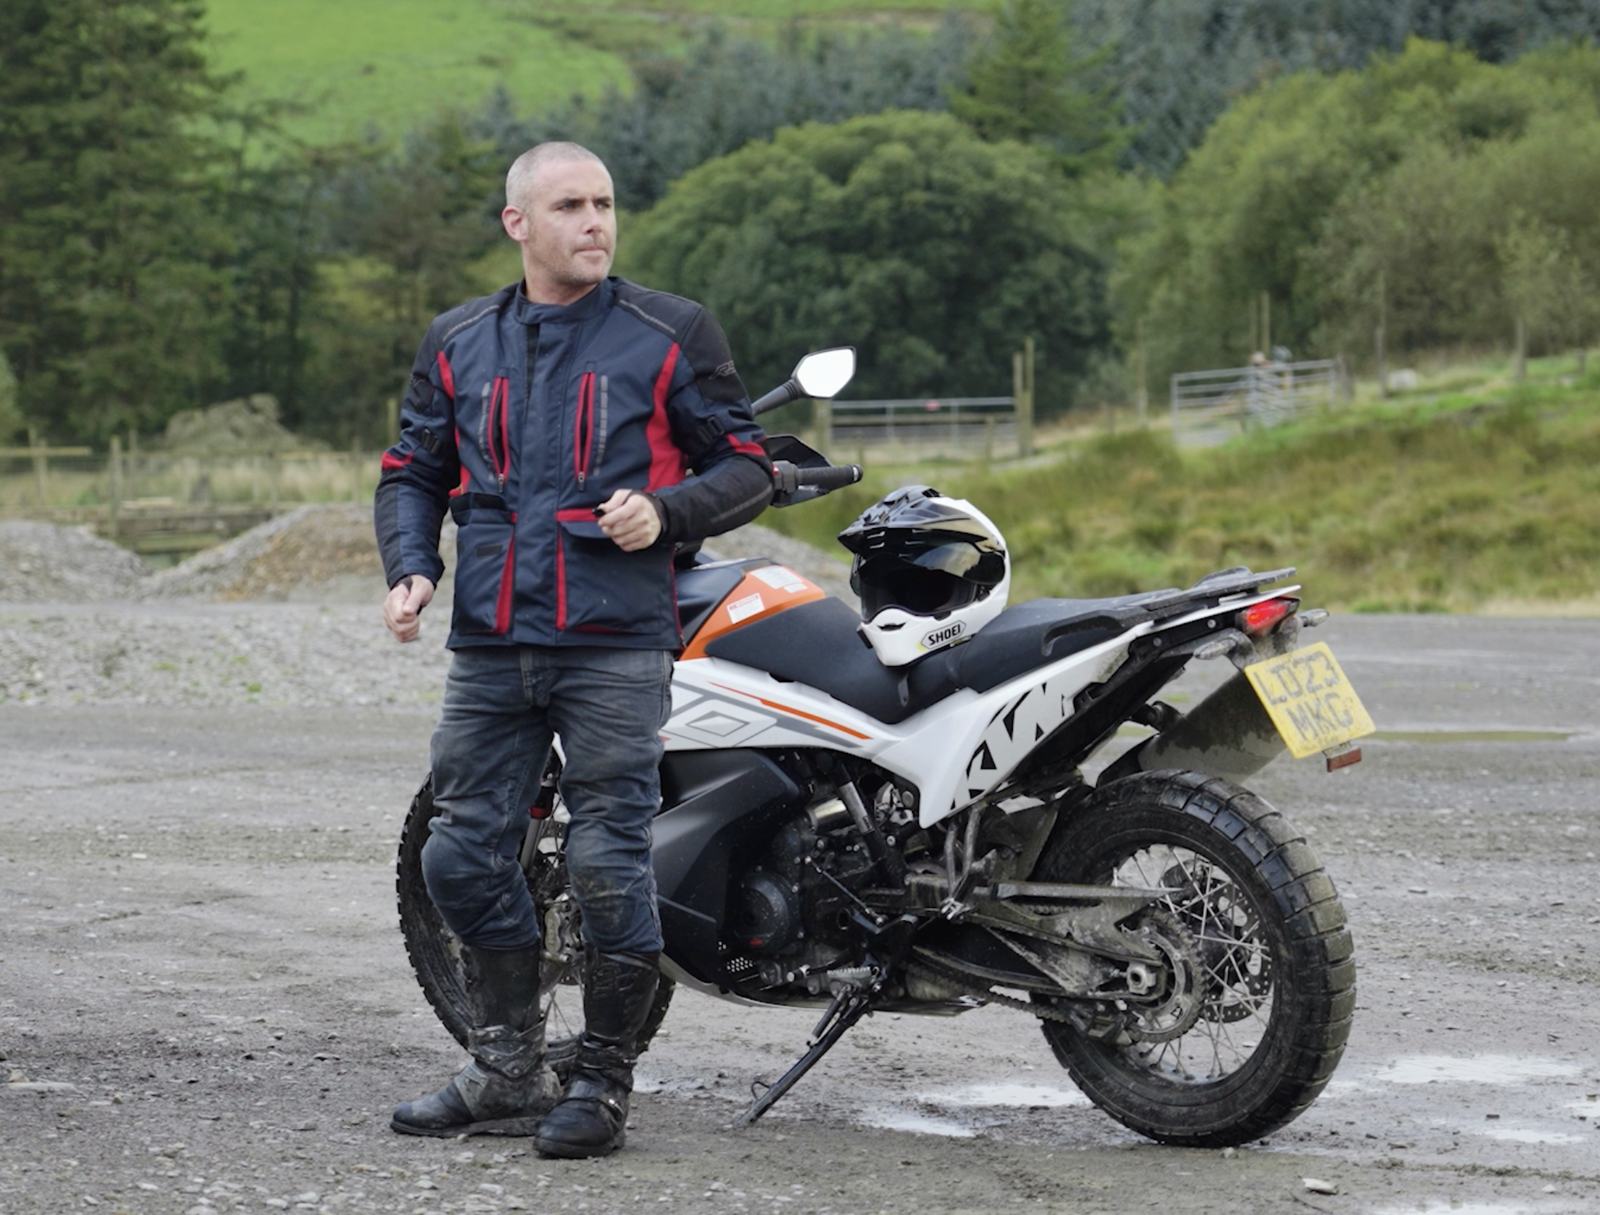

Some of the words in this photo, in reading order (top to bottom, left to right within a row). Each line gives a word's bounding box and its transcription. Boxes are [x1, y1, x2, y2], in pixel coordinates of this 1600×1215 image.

[708, 359, 736, 379] RS
[928, 624, 961, 646] SHOEI
[950, 681, 1066, 810] KTM
